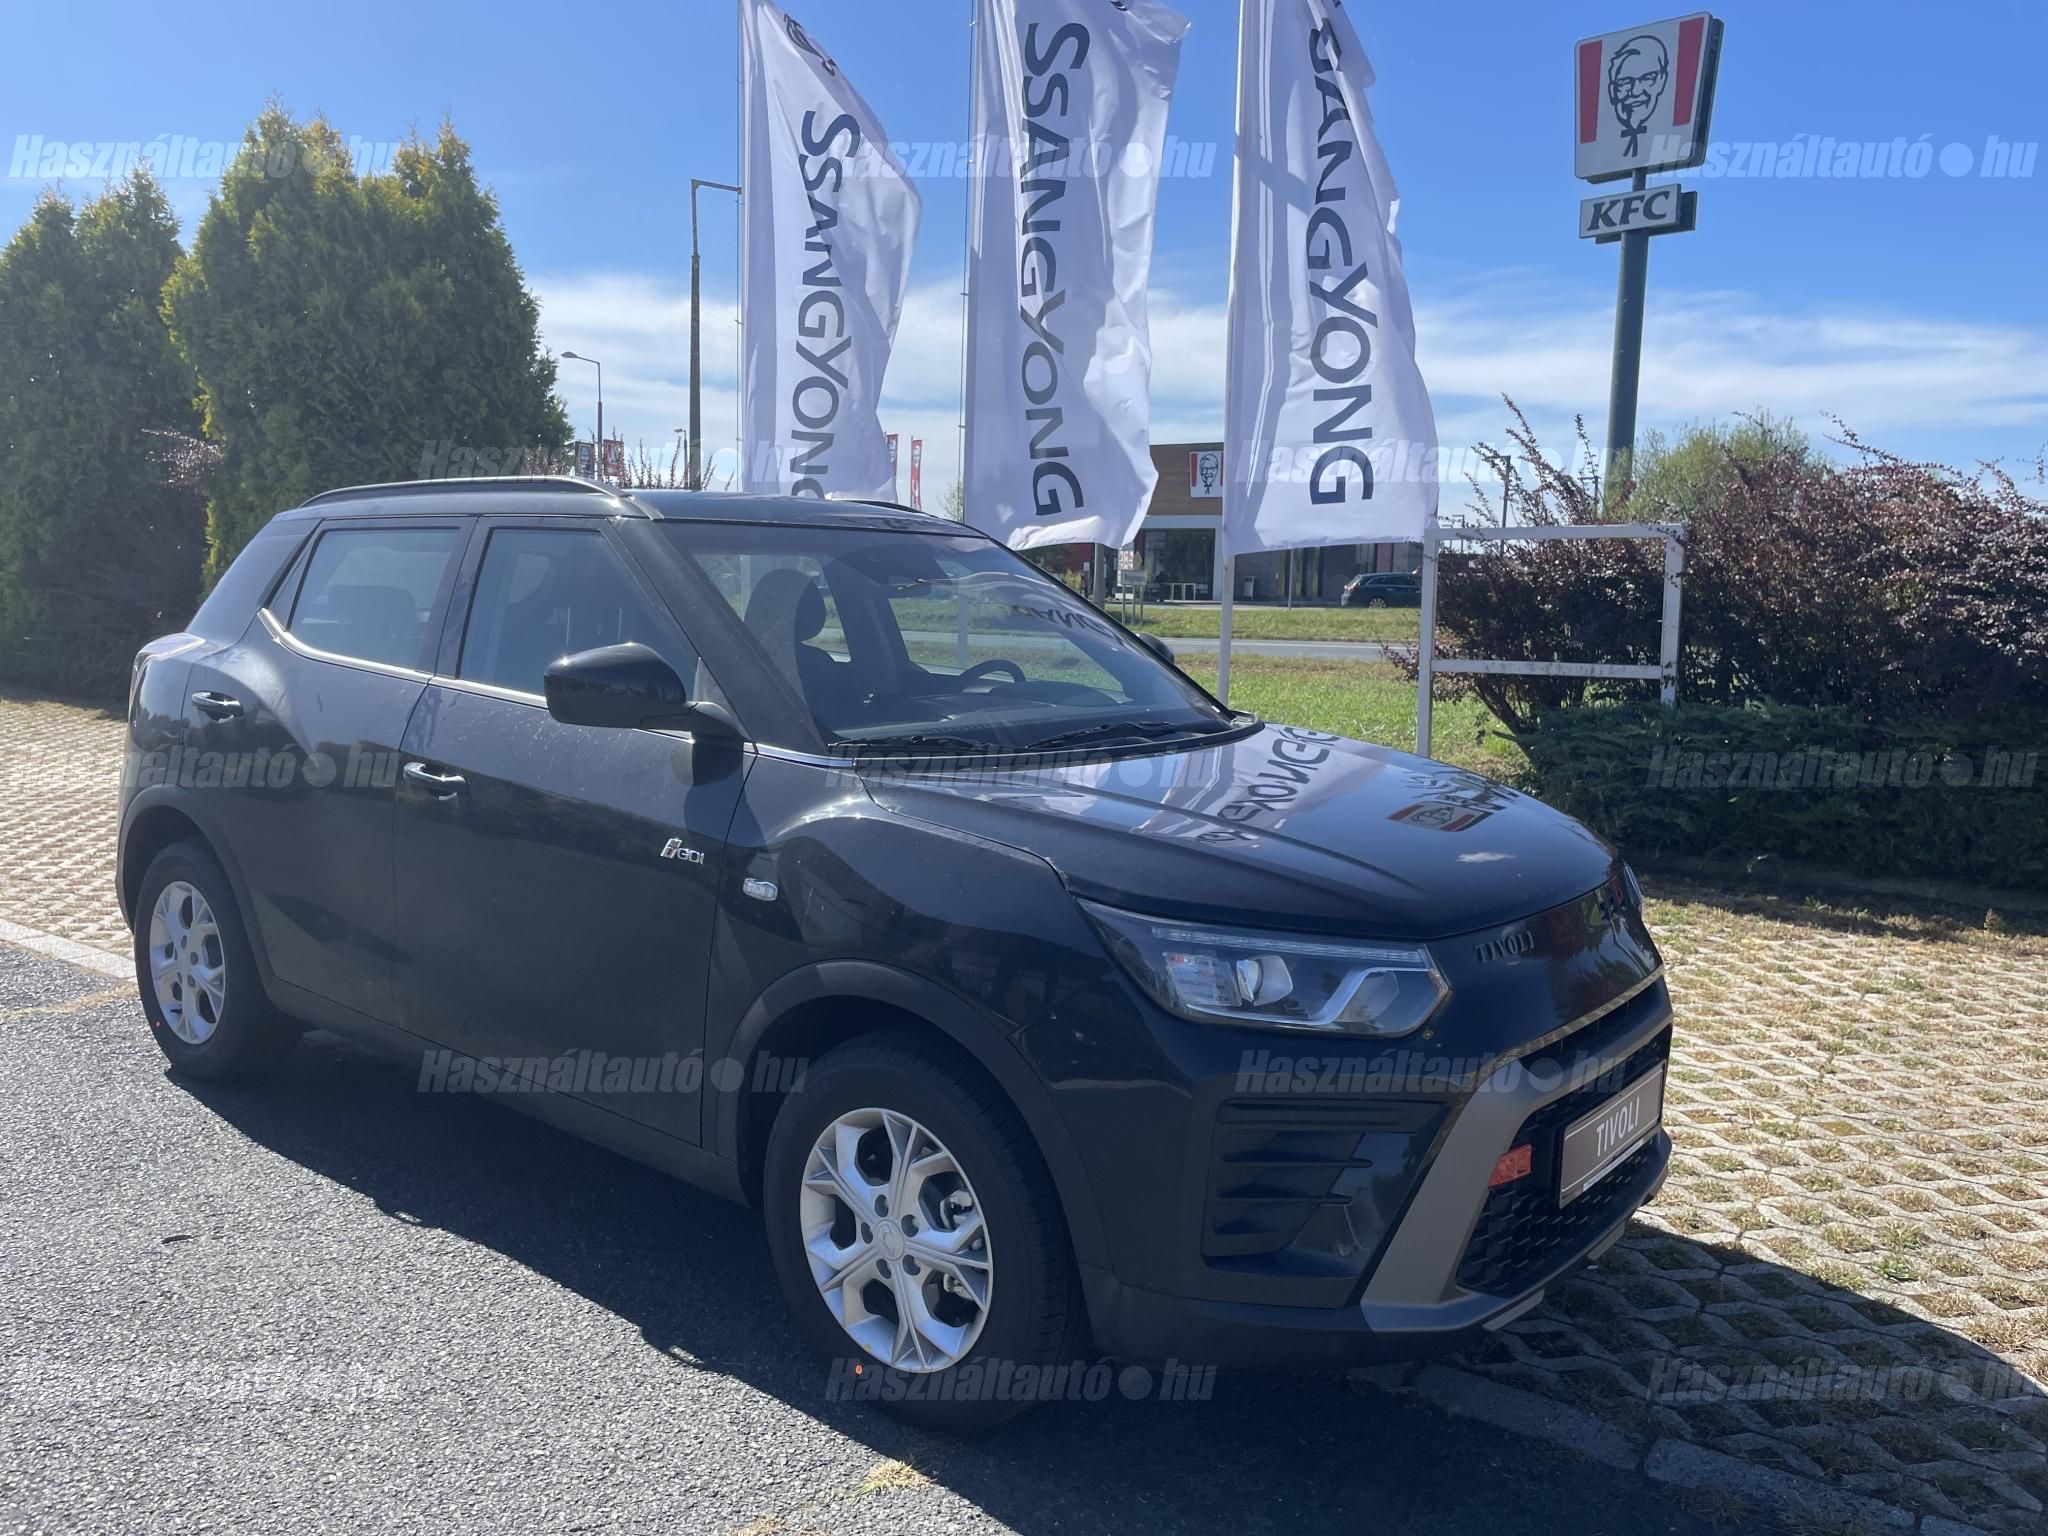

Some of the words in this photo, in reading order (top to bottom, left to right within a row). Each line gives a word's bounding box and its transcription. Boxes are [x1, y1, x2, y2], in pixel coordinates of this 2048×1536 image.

[1586, 190, 1670, 231] KFC
[1020, 22, 1090, 517] SSANGYONG
[1596, 1096, 1640, 1157] TIVOLI
